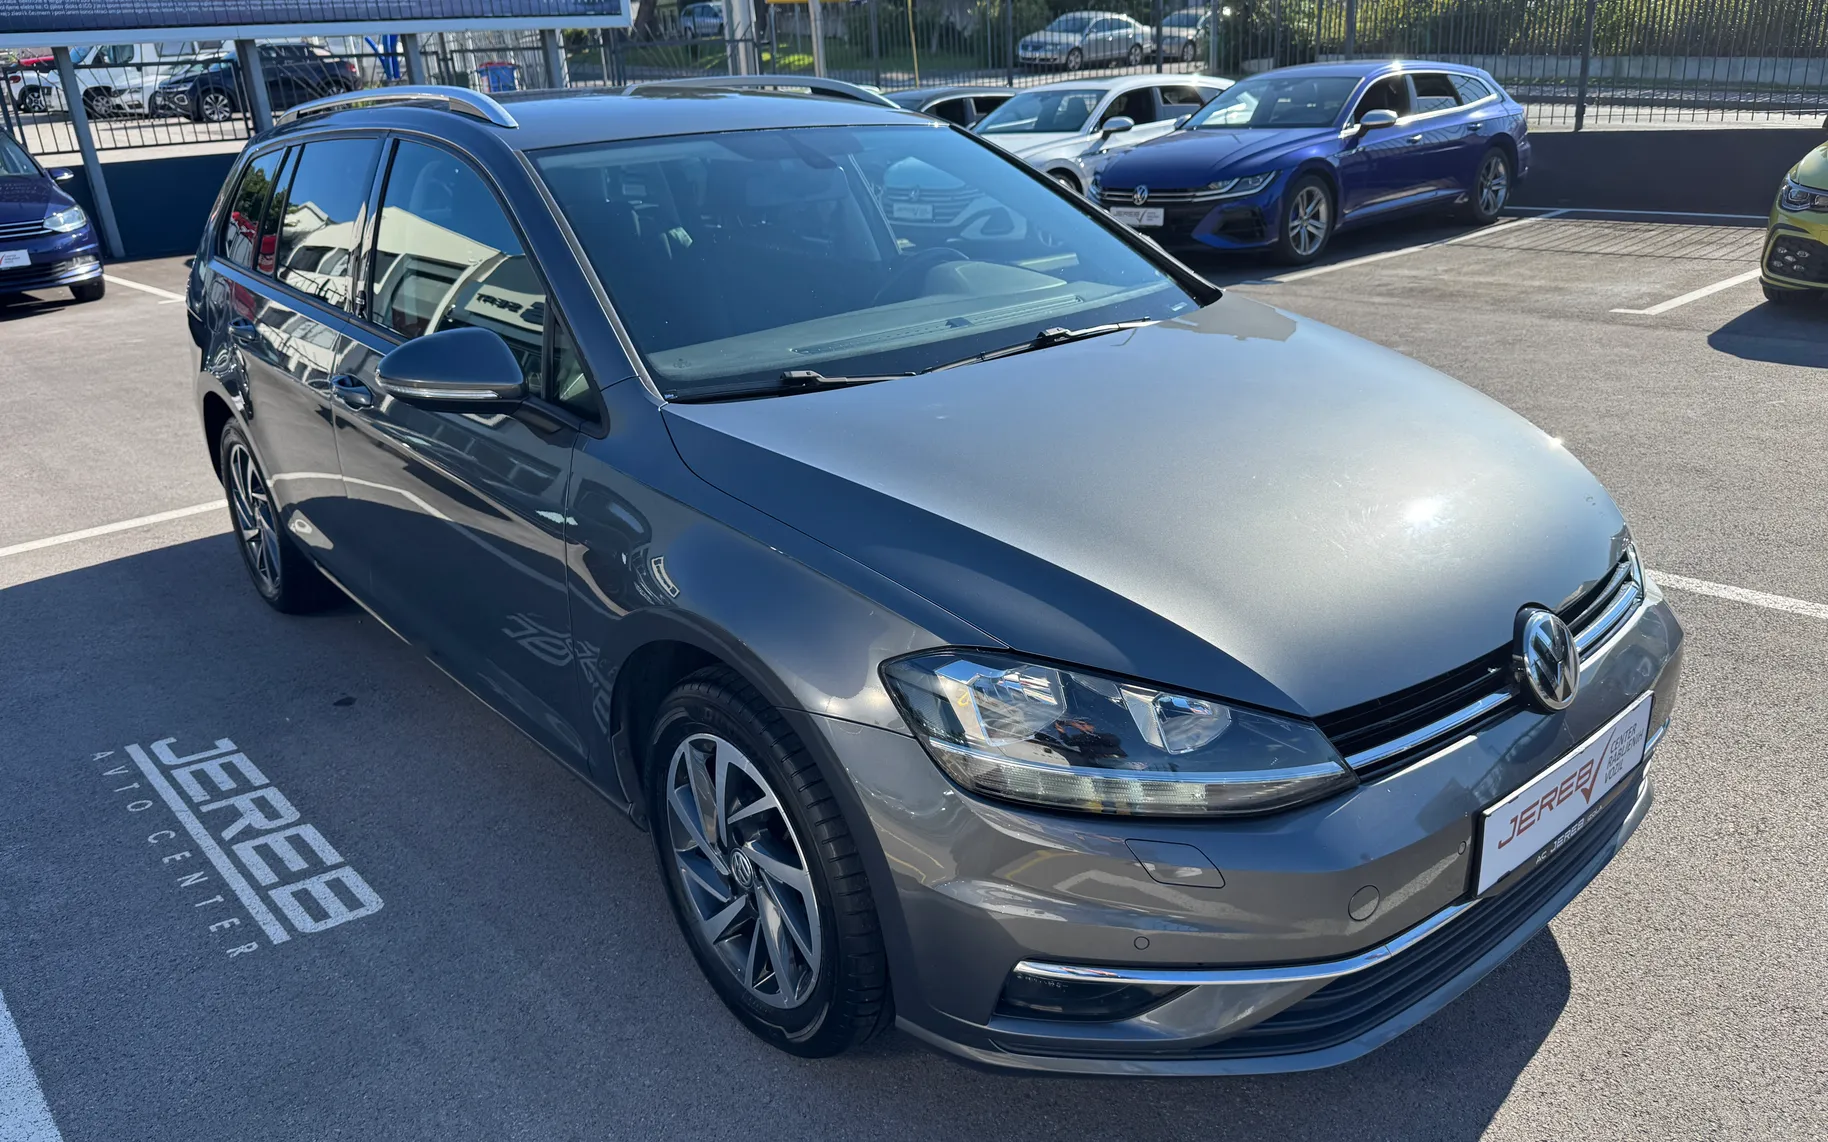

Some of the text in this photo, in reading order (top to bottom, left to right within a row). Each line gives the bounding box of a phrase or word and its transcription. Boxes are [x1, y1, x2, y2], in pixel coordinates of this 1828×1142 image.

[1610, 723, 1637, 754] CENTER
[150, 737, 384, 933] JEREB
[1498, 758, 1595, 849] JEREB
[1550, 817, 1585, 853] JEREB
[89, 750, 258, 958] AVTO CENTER
